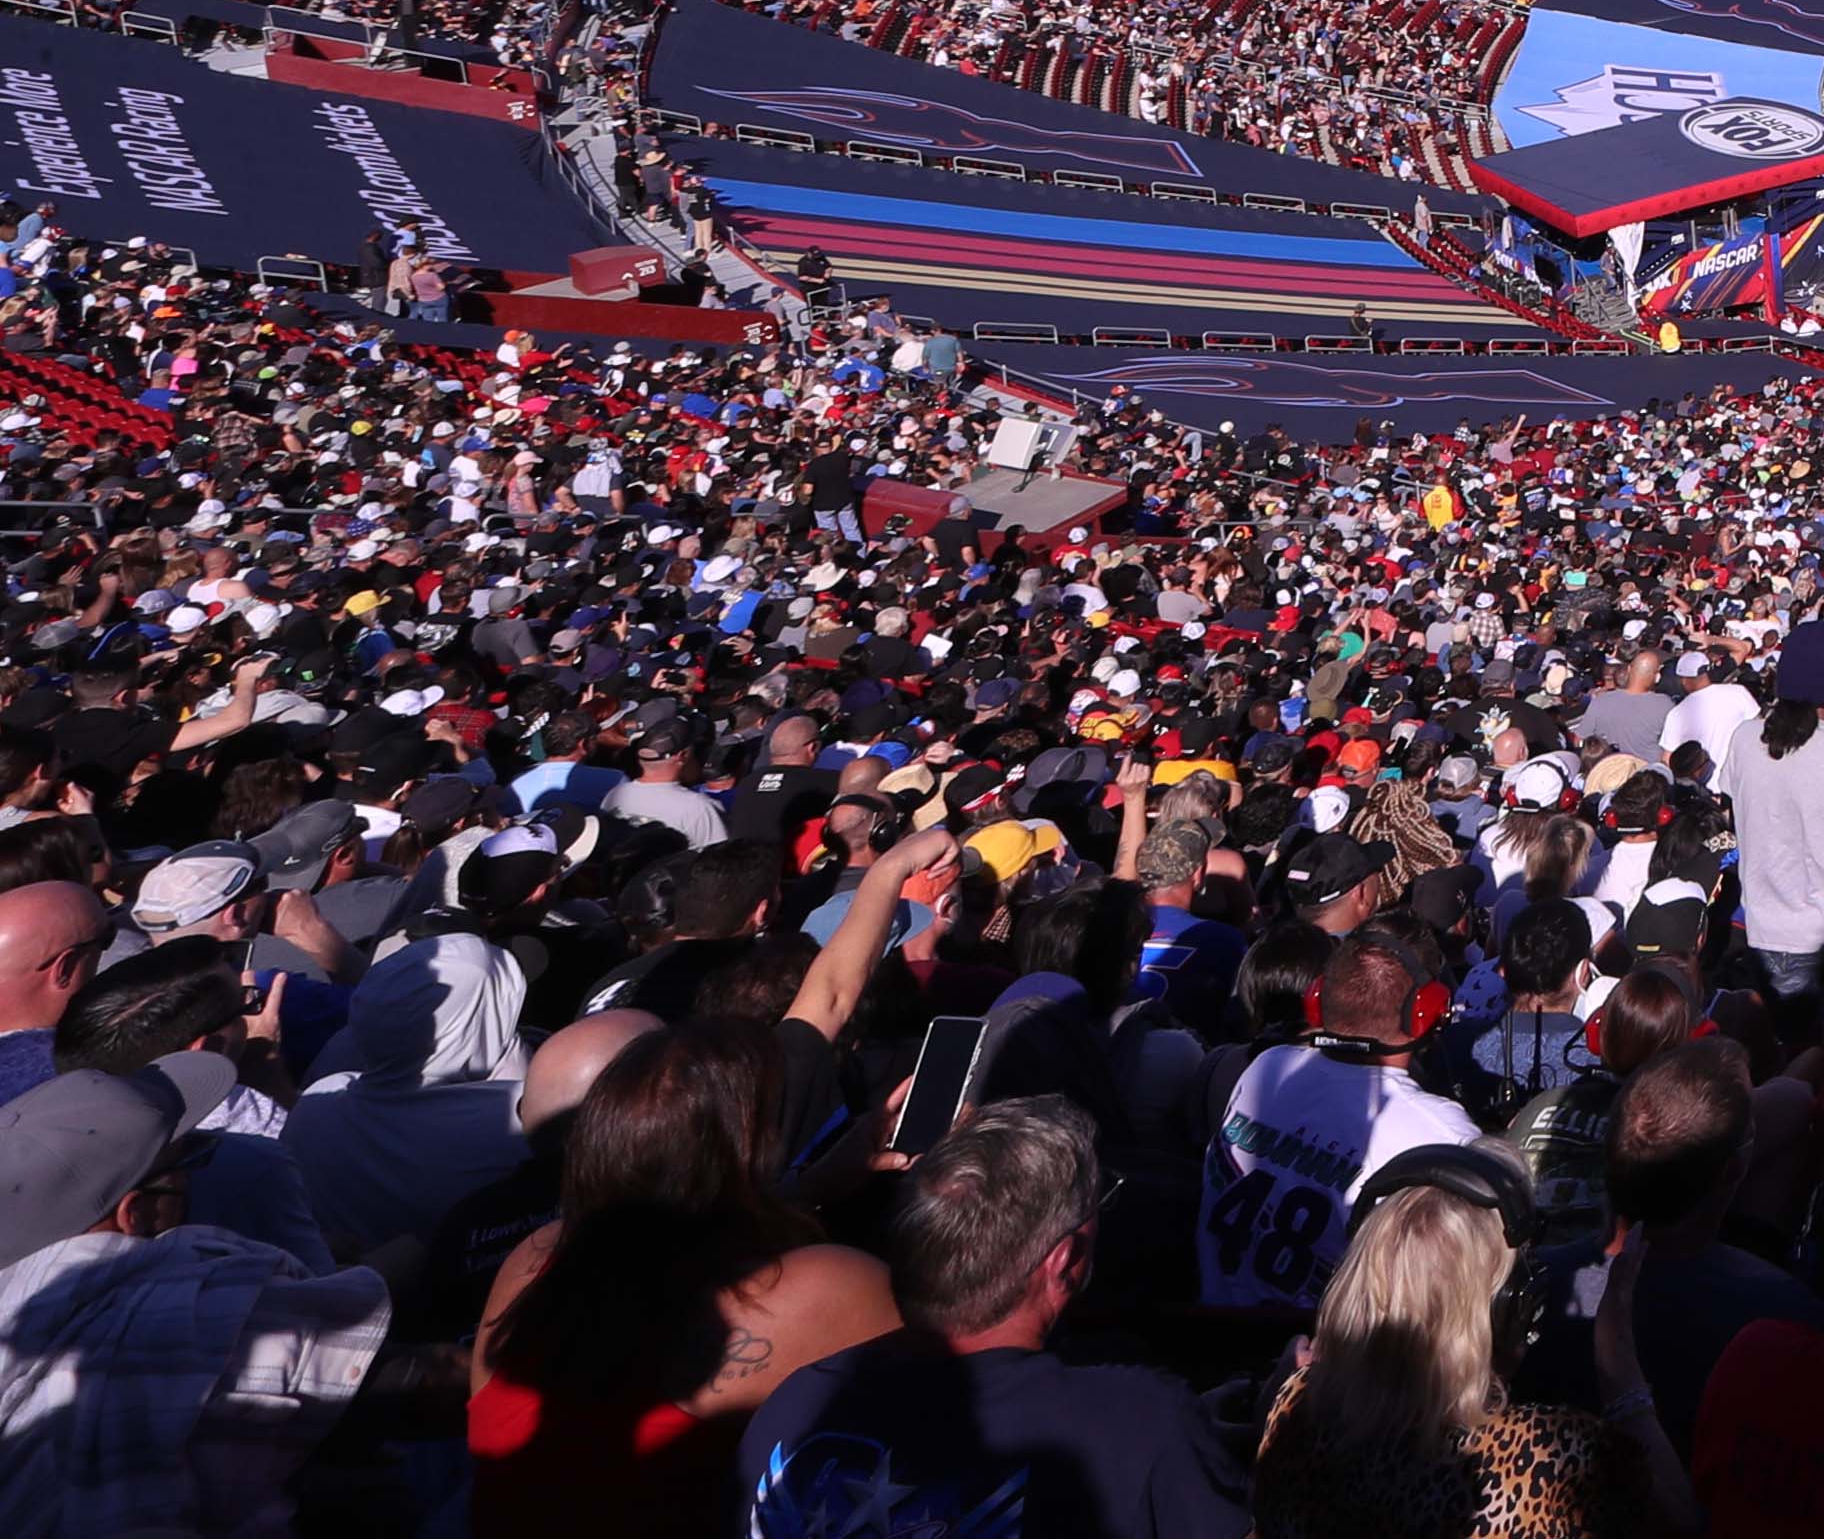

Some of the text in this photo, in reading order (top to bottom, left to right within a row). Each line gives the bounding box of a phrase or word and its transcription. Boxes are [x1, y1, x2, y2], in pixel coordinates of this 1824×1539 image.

[1699, 114, 1793, 152] FOX
[1741, 109, 1814, 142] SPORTS
[102, 85, 230, 216] NASCAR Racing
[1692, 243, 1758, 280] NASCAR
[1221, 1109, 1364, 1189] BOWMAN
[1295, 1126, 1356, 1157] ALEX
[1207, 1167, 1334, 1297] 48
